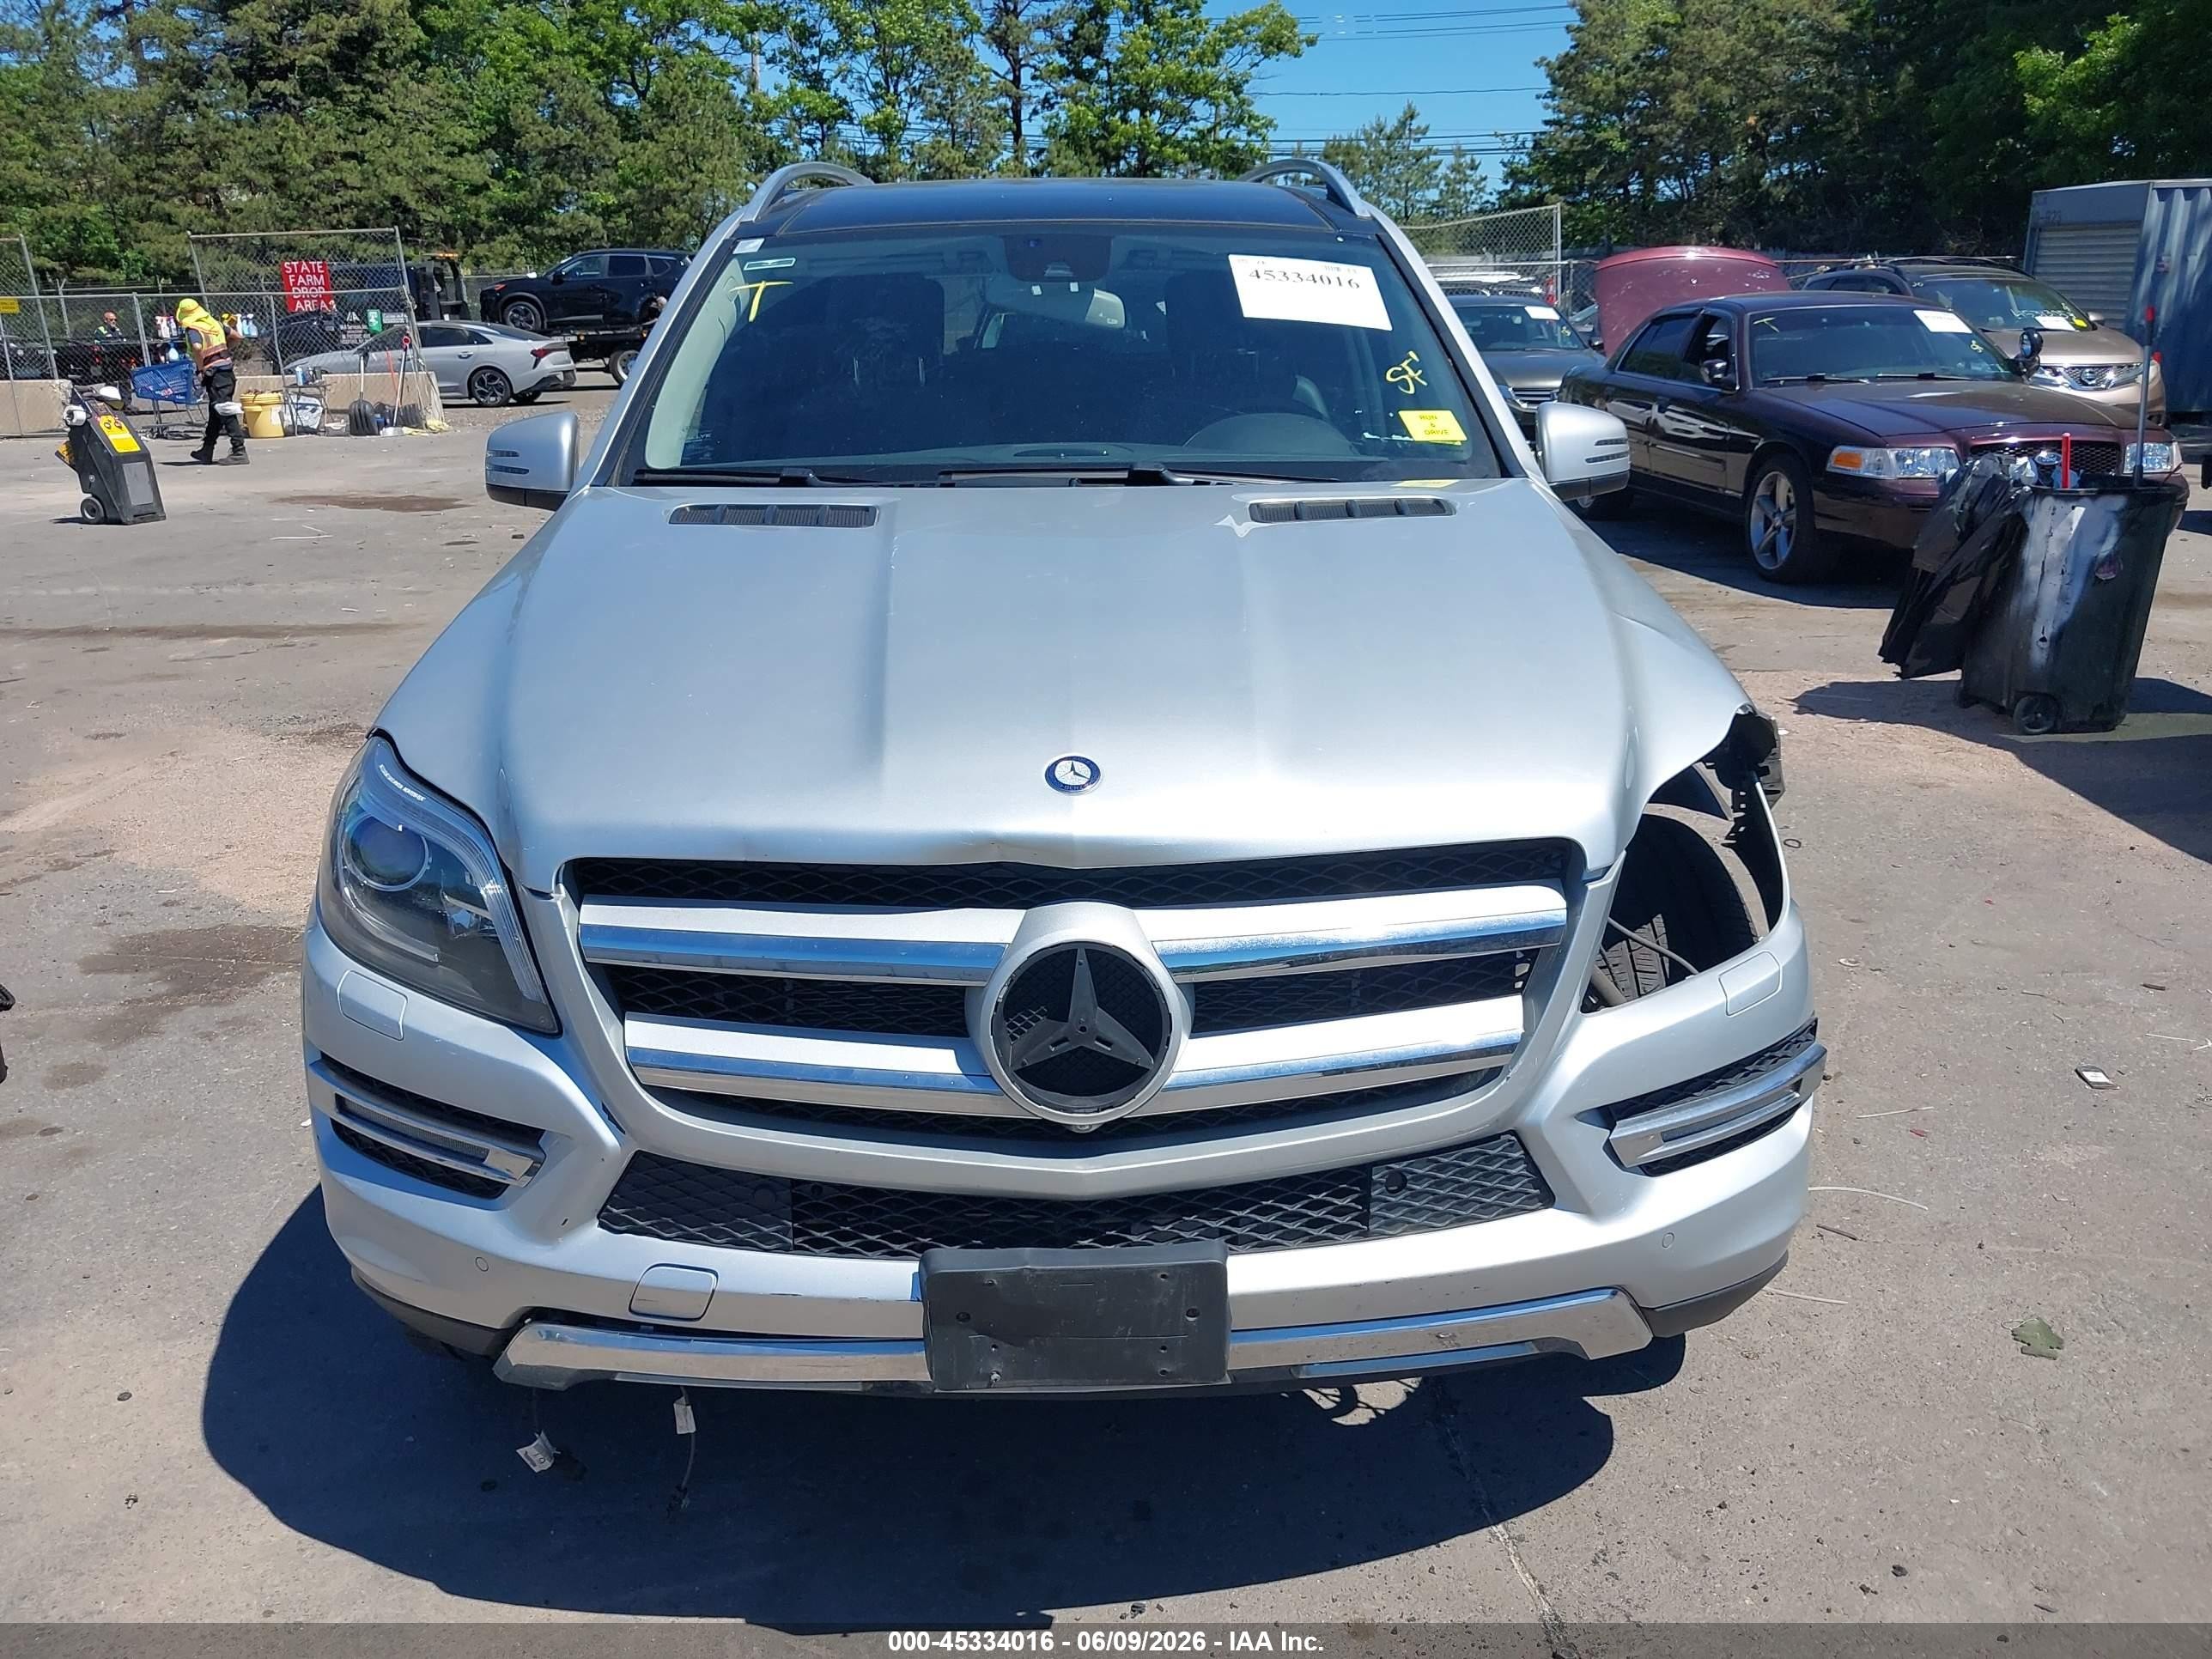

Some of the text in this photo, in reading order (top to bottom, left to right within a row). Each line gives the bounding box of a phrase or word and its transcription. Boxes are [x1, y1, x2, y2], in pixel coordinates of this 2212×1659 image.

[284, 261, 325, 273] STATE
[289, 274, 325, 286] FARM
[1249, 269, 1360, 289] 45334016
[292, 286, 325, 298] DROP
